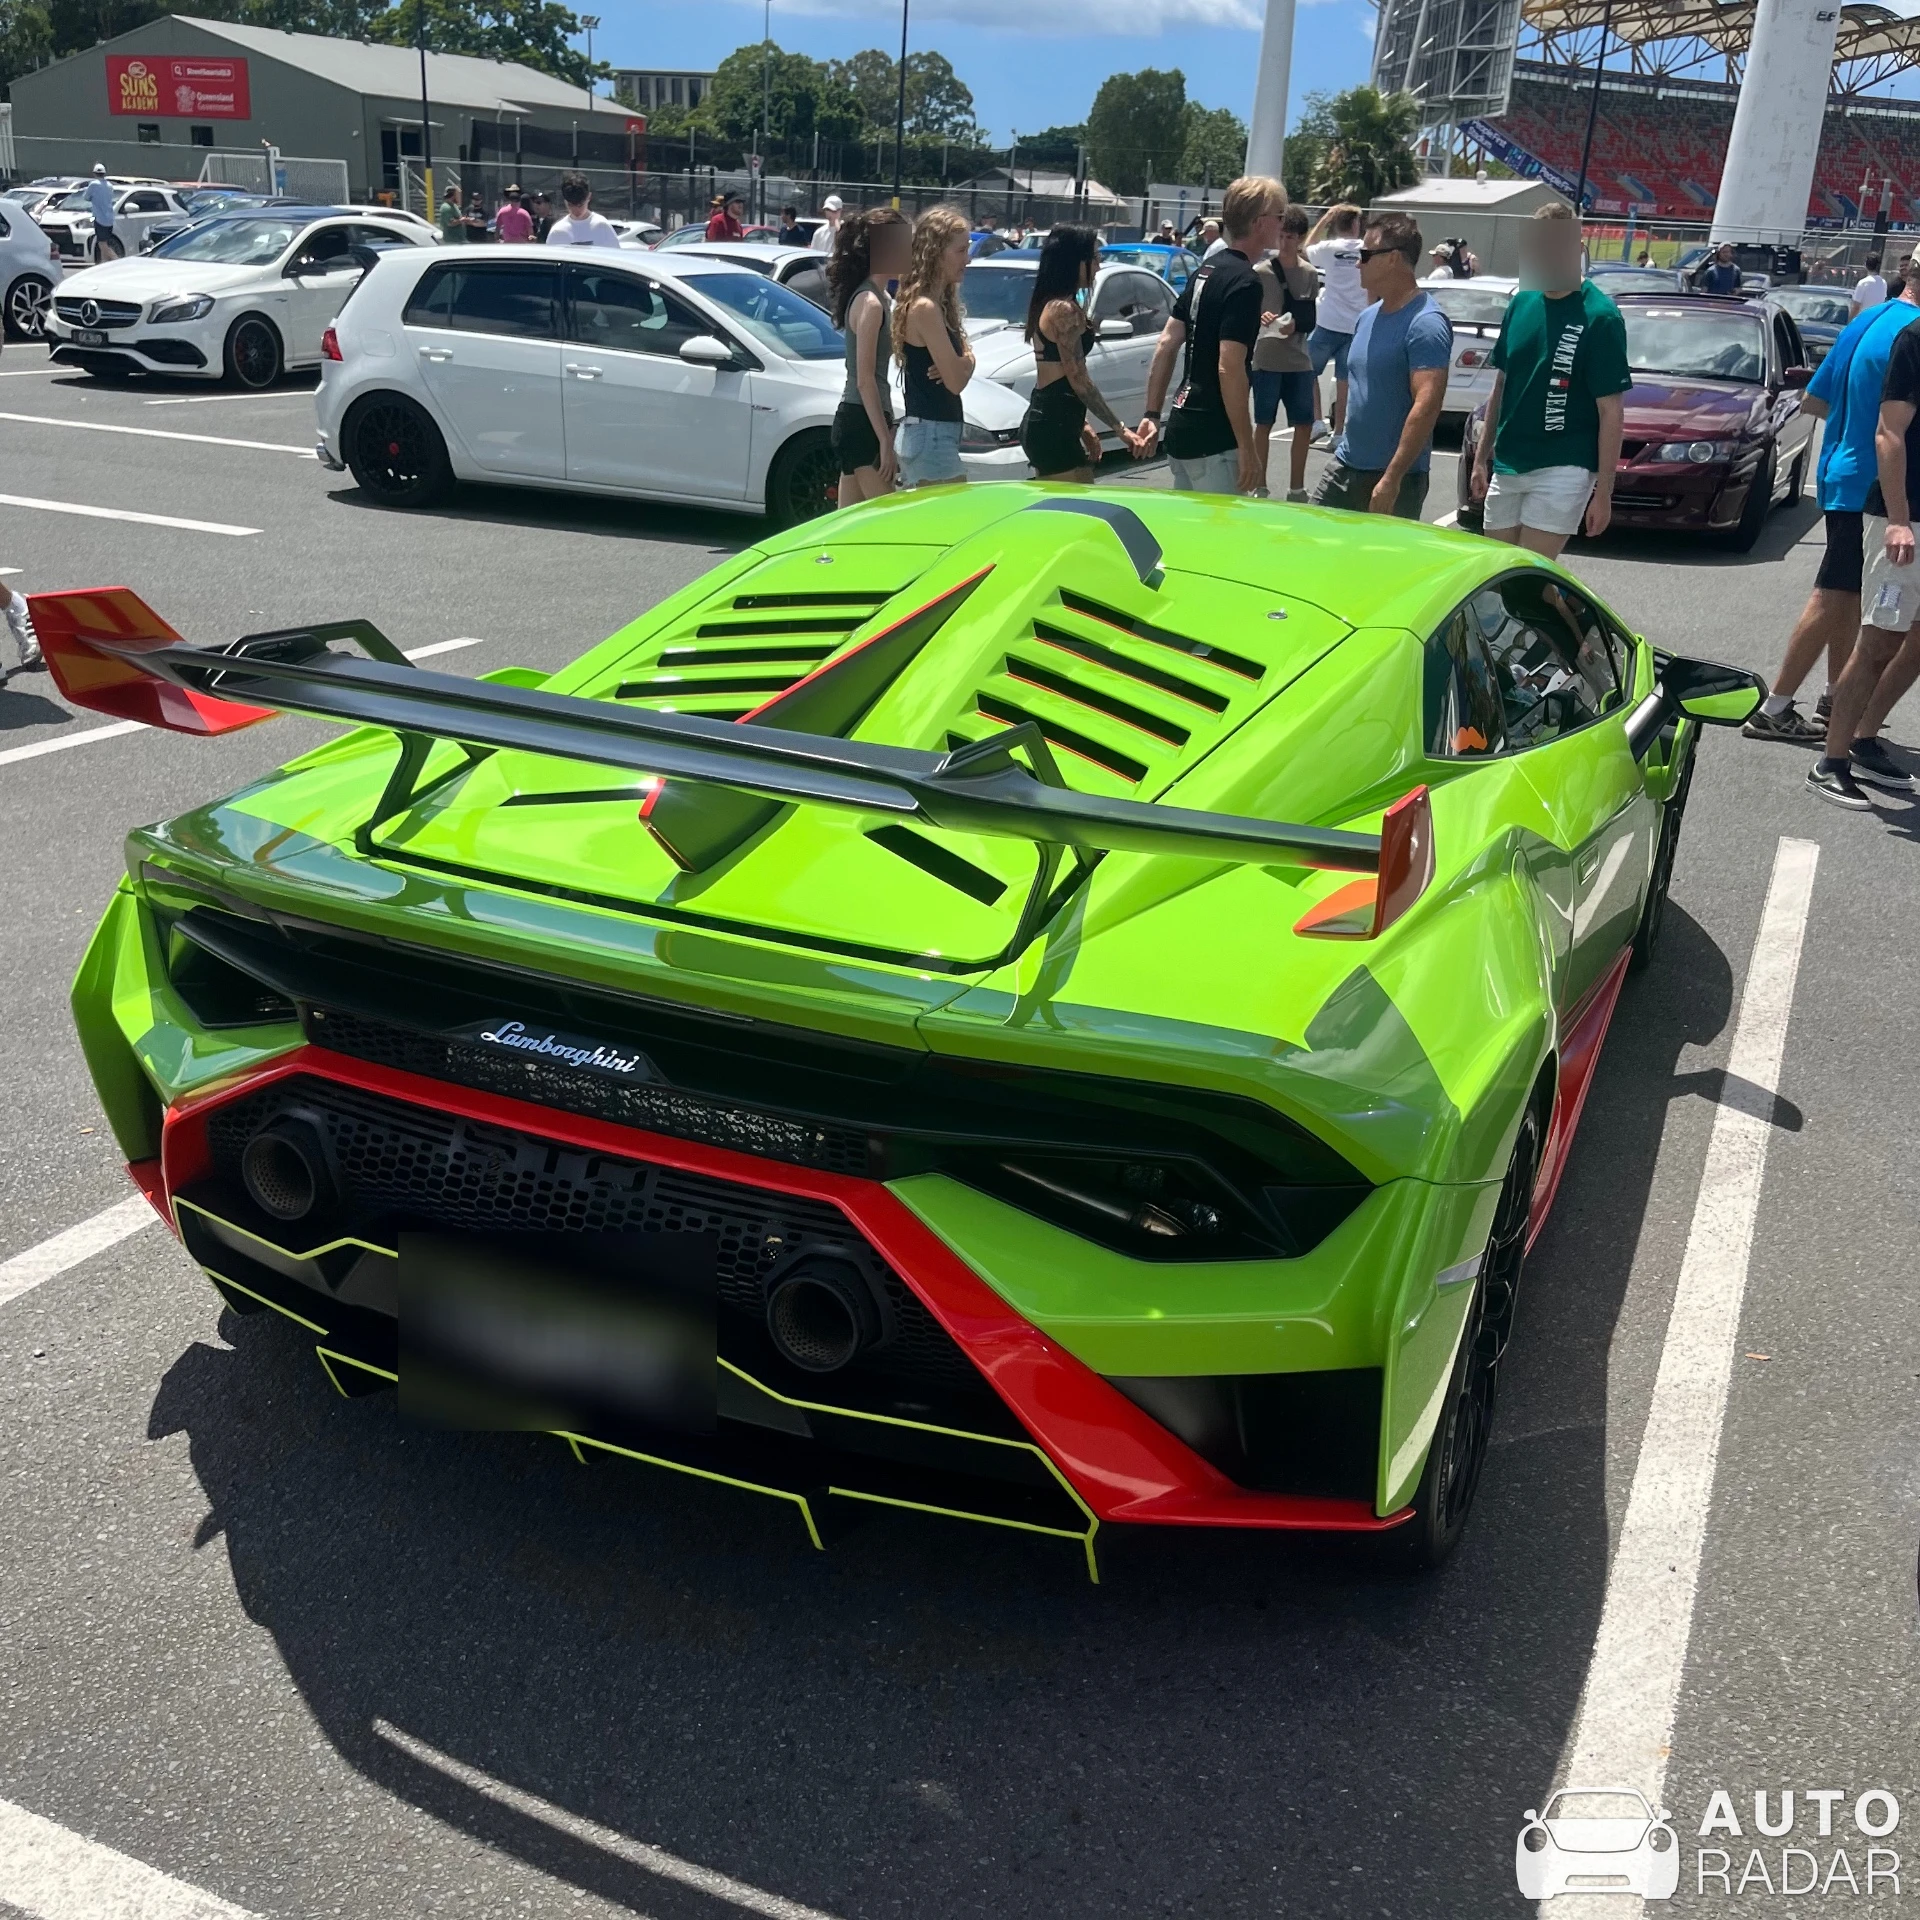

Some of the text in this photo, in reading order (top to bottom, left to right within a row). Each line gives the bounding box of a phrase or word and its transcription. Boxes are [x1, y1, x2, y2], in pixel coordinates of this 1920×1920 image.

[120, 73, 158, 96] SUNS
[122, 96, 159, 111] ACADEMY
[1545, 324, 1584, 431] TOMMY JEANS
[480, 1021, 640, 1073] Lamborghini
